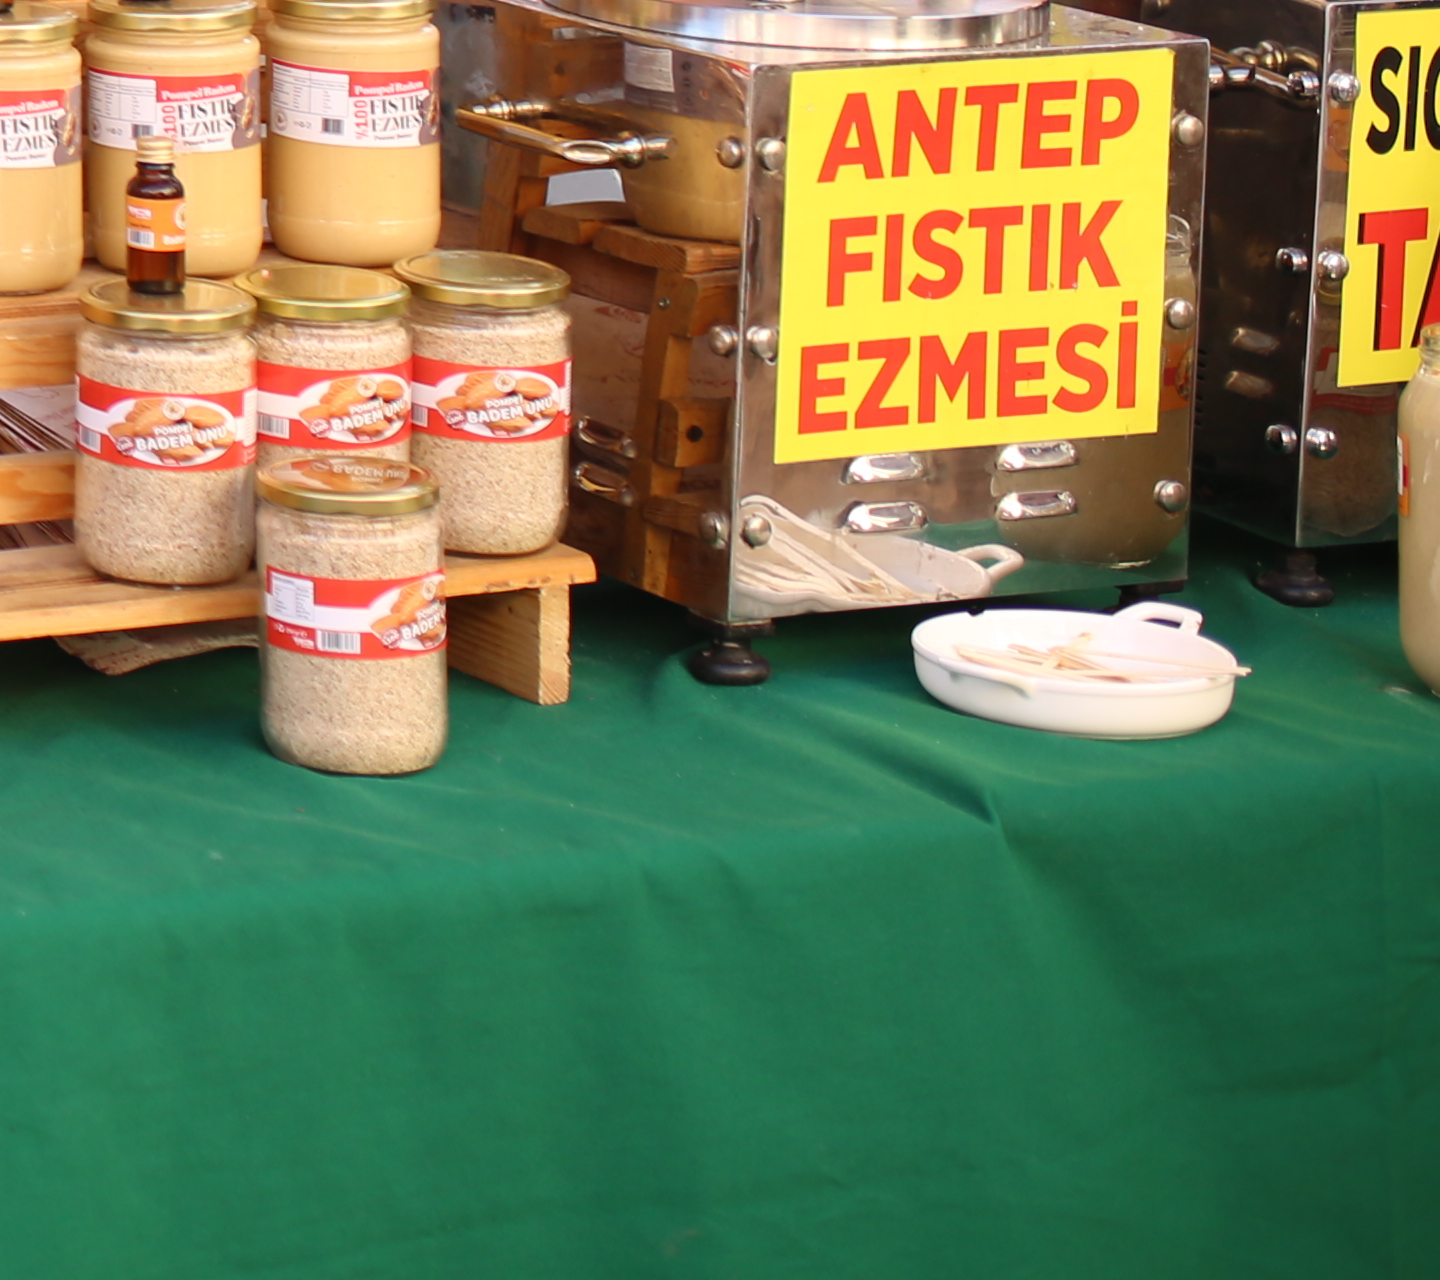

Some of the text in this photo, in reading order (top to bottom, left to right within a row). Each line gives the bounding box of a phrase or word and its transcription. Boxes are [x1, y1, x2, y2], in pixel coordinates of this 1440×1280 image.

[817, 77, 1140, 183] ANTEP
[826, 199, 1123, 308] FISTIK
[797, 300, 1139, 436] EZMESİ
[135, 434, 194, 451] BADEM
[196, 425, 228, 444] UNU
[331, 409, 384, 431] BADEM
[385, 398, 407, 417] UNU
[466, 406, 524, 424] BADEM
[526, 396, 553, 415] UNU
